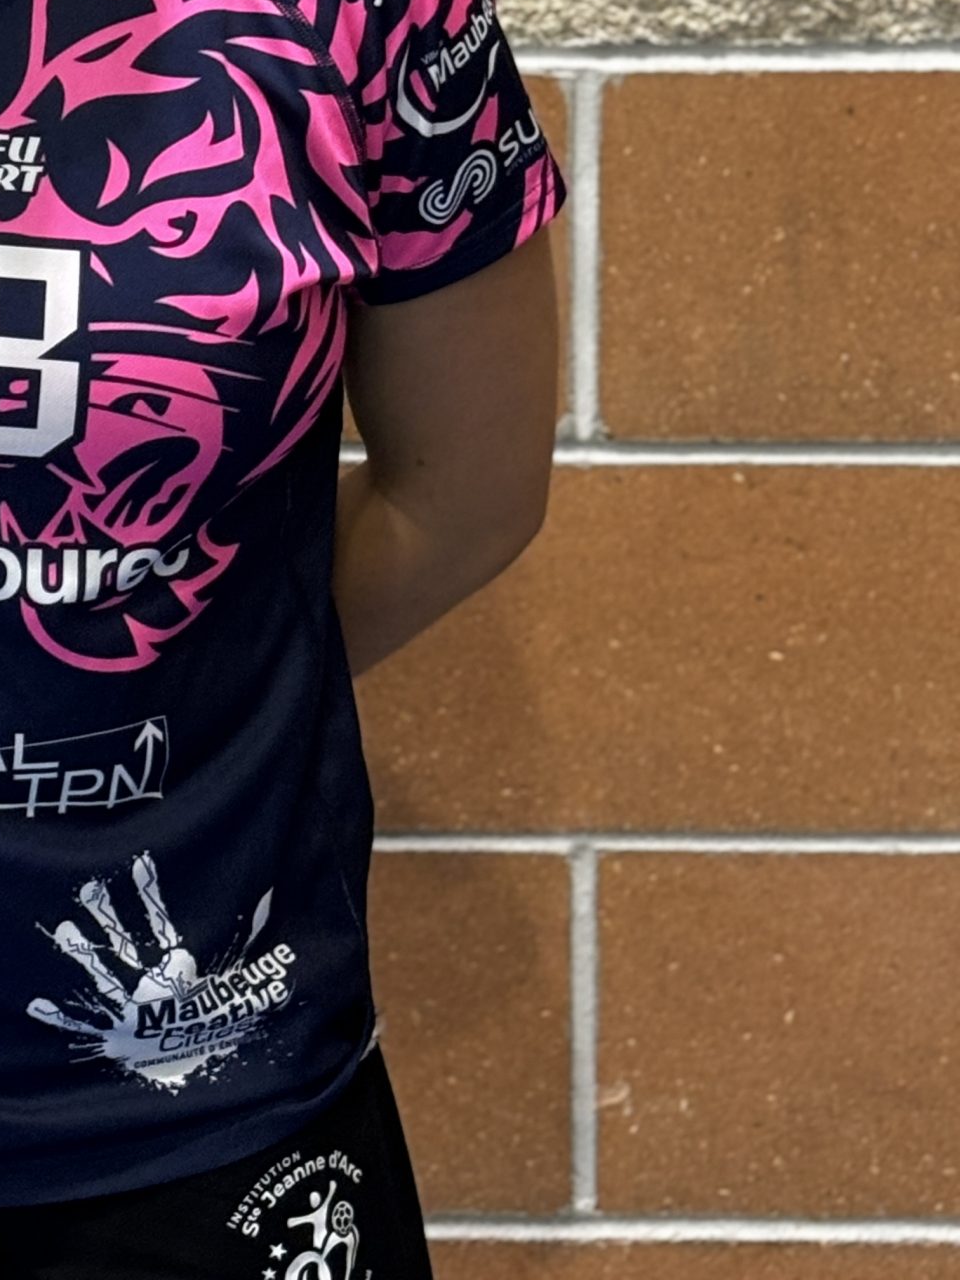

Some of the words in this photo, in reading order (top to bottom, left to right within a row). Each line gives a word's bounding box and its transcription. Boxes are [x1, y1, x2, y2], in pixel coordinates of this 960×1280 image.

[13, 745, 154, 818] TPN
[136, 943, 296, 1031] Maubeuge
[226, 1150, 302, 1229] INSTITUTION
[260, 1155, 326, 1209] Jeanne
[328, 1149, 363, 1184] d'Arc
